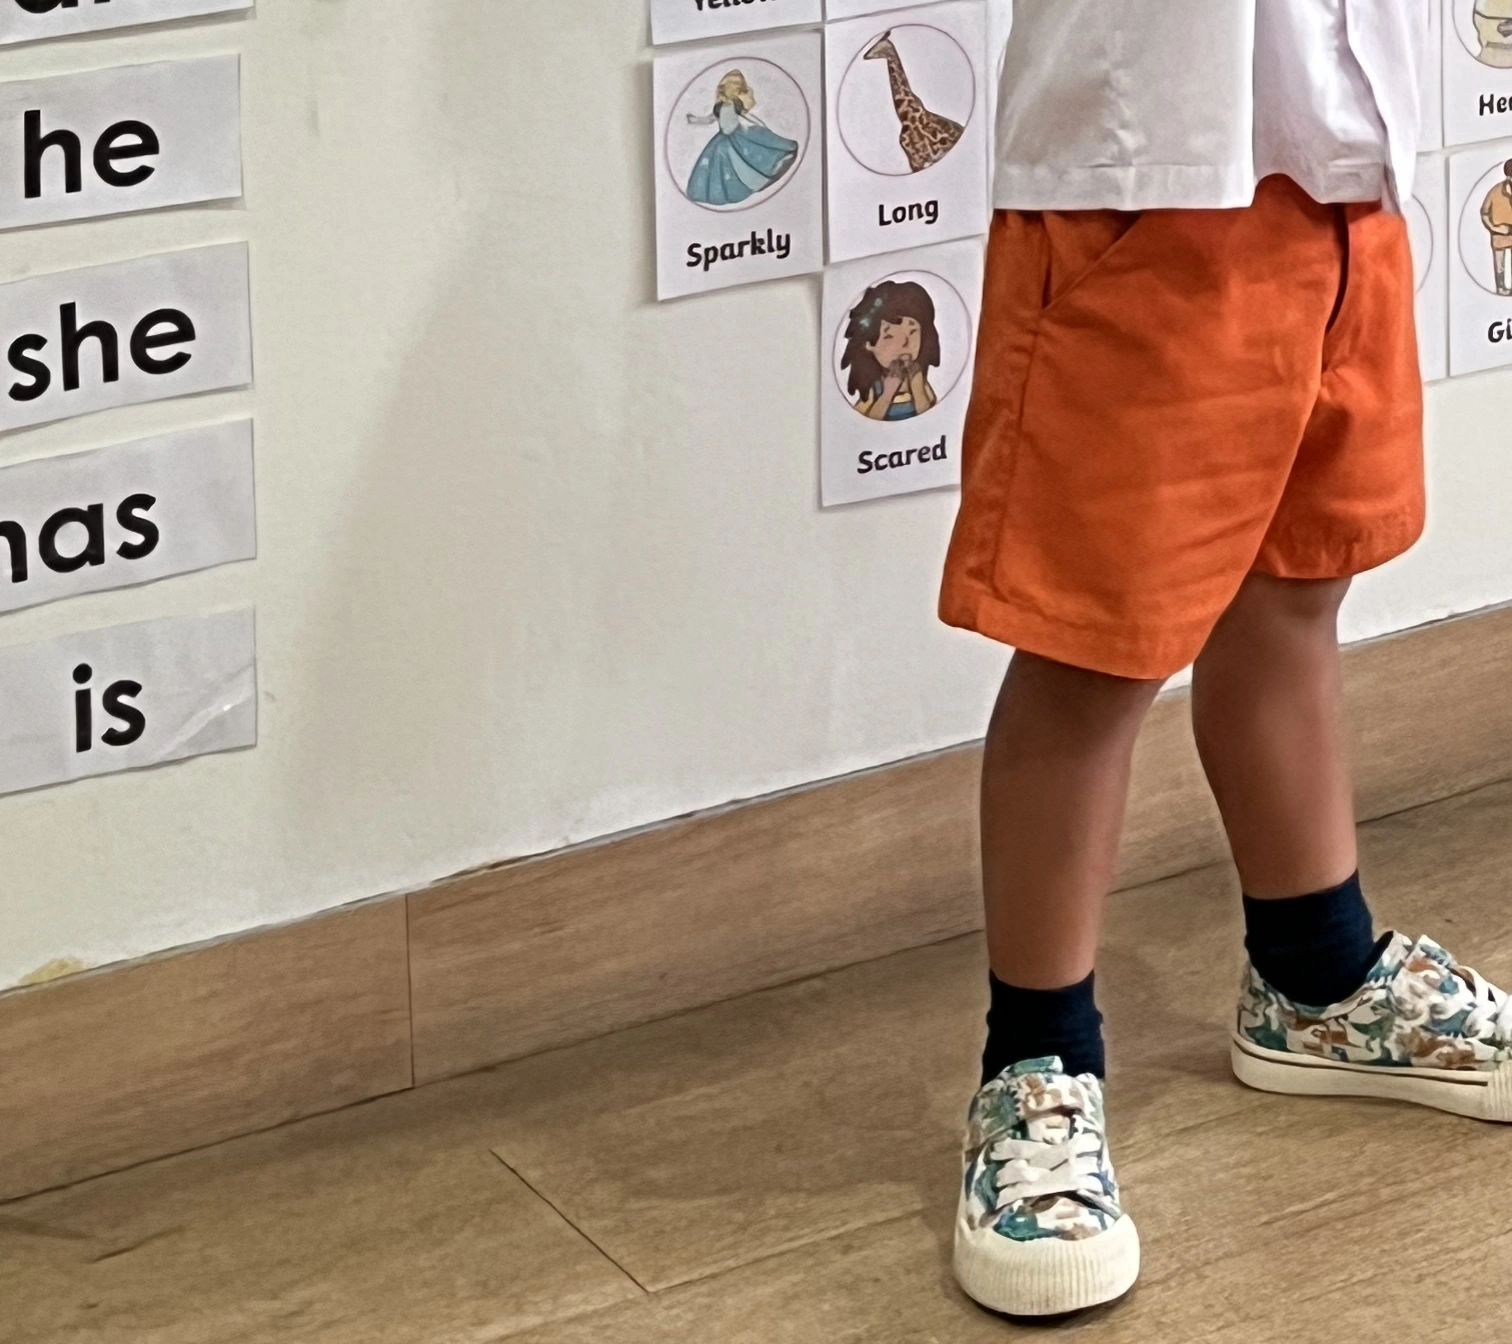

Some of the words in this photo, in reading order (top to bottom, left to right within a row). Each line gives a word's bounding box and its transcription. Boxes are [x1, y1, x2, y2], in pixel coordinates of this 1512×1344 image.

[24, 109, 160, 199] he
[878, 200, 939, 226] Long
[686, 228, 791, 272] Sparkly
[7, 301, 197, 402] she
[856, 435, 947, 474] Scared
[72, 663, 147, 753] is
